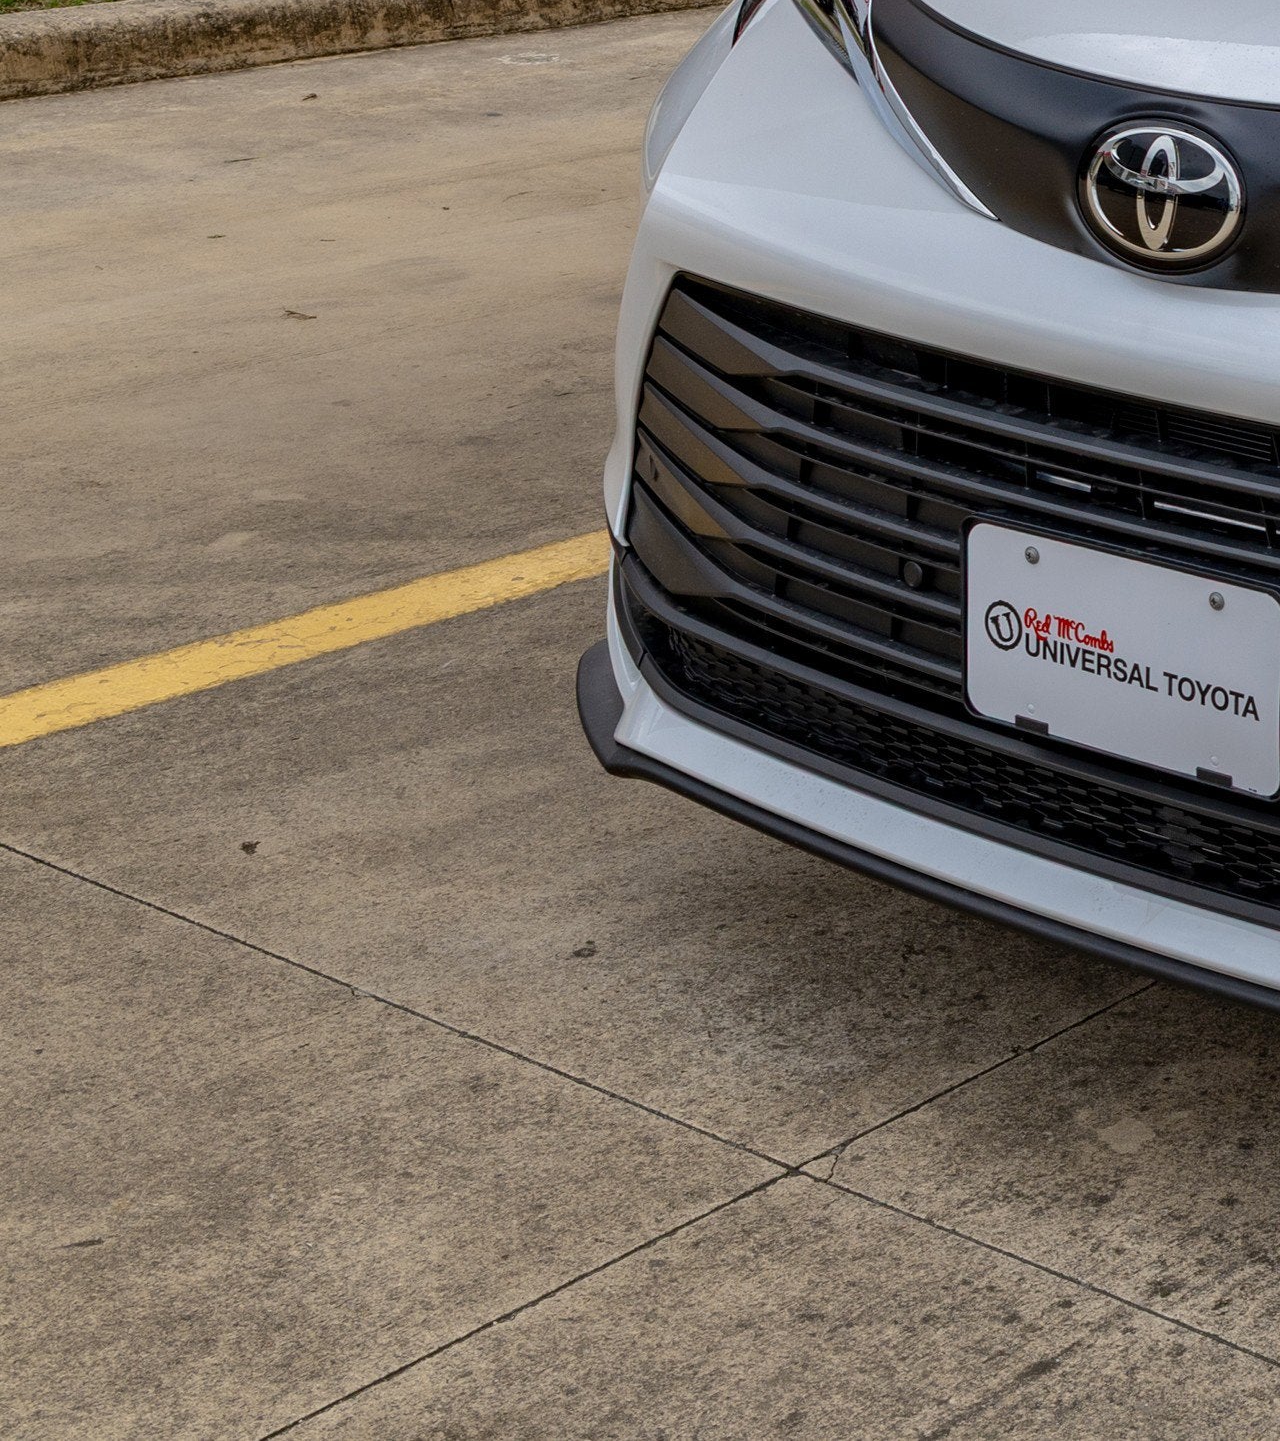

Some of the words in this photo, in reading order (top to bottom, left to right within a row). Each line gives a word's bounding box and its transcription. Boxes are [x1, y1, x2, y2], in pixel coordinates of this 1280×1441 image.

[1024, 607, 1052, 641] Red
[1053, 614, 1114, 653] McCombs
[1025, 632, 1159, 693] UNIVERSAL
[1163, 671, 1261, 722] TOYOTA
